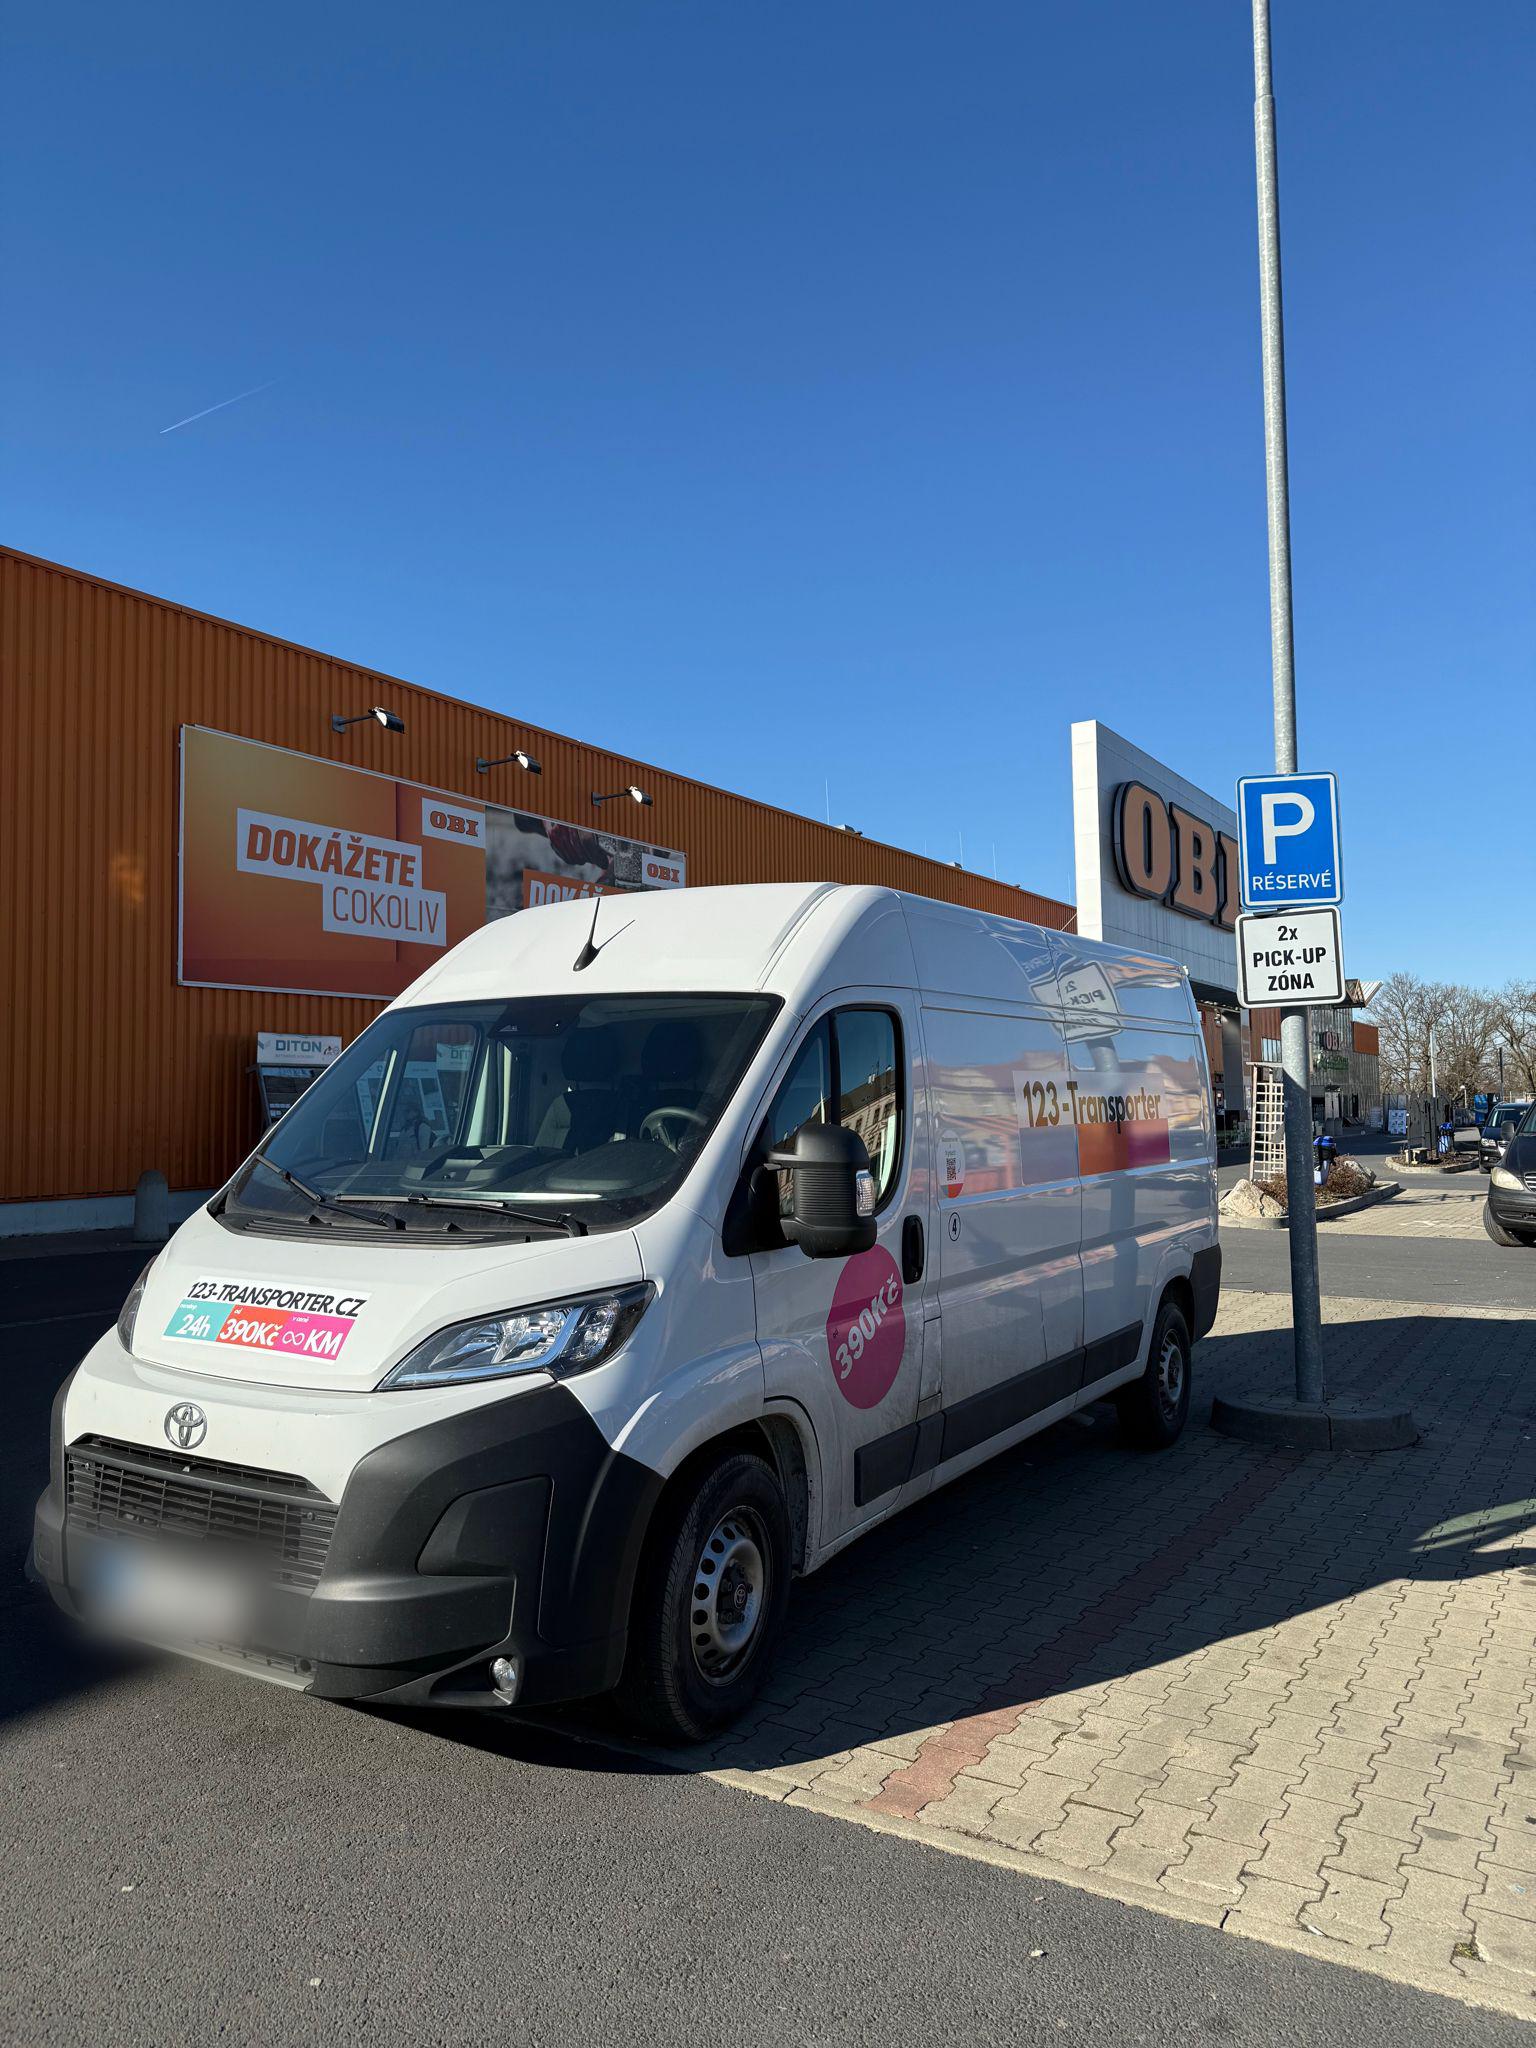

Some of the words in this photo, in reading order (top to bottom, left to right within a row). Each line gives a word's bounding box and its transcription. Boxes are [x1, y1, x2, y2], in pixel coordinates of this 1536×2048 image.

[430, 810, 479, 838] OBI
[1261, 792, 1315, 865] P
[246, 823, 417, 888] DOKÁŽETE
[1113, 780, 1242, 932] OBI
[646, 862, 680, 883] OBI
[1252, 869, 1332, 891] RÉSERVÉ
[332, 886, 440, 934] COKOLIV
[1277, 925, 1298, 942] 2x
[1252, 946, 1327, 968] PICK-UP
[1267, 970, 1315, 992] ZÓNA
[275, 1039, 322, 1053] DITON
[951, 1218, 957, 1236] 4
[186, 1281, 368, 1318] 123-TRANSPORTER.CZ
[175, 1313, 211, 1338] 24h
[219, 1318, 284, 1347] 390Kč
[835, 1272, 899, 1380] 390Kč
[303, 1328, 344, 1356] KM
